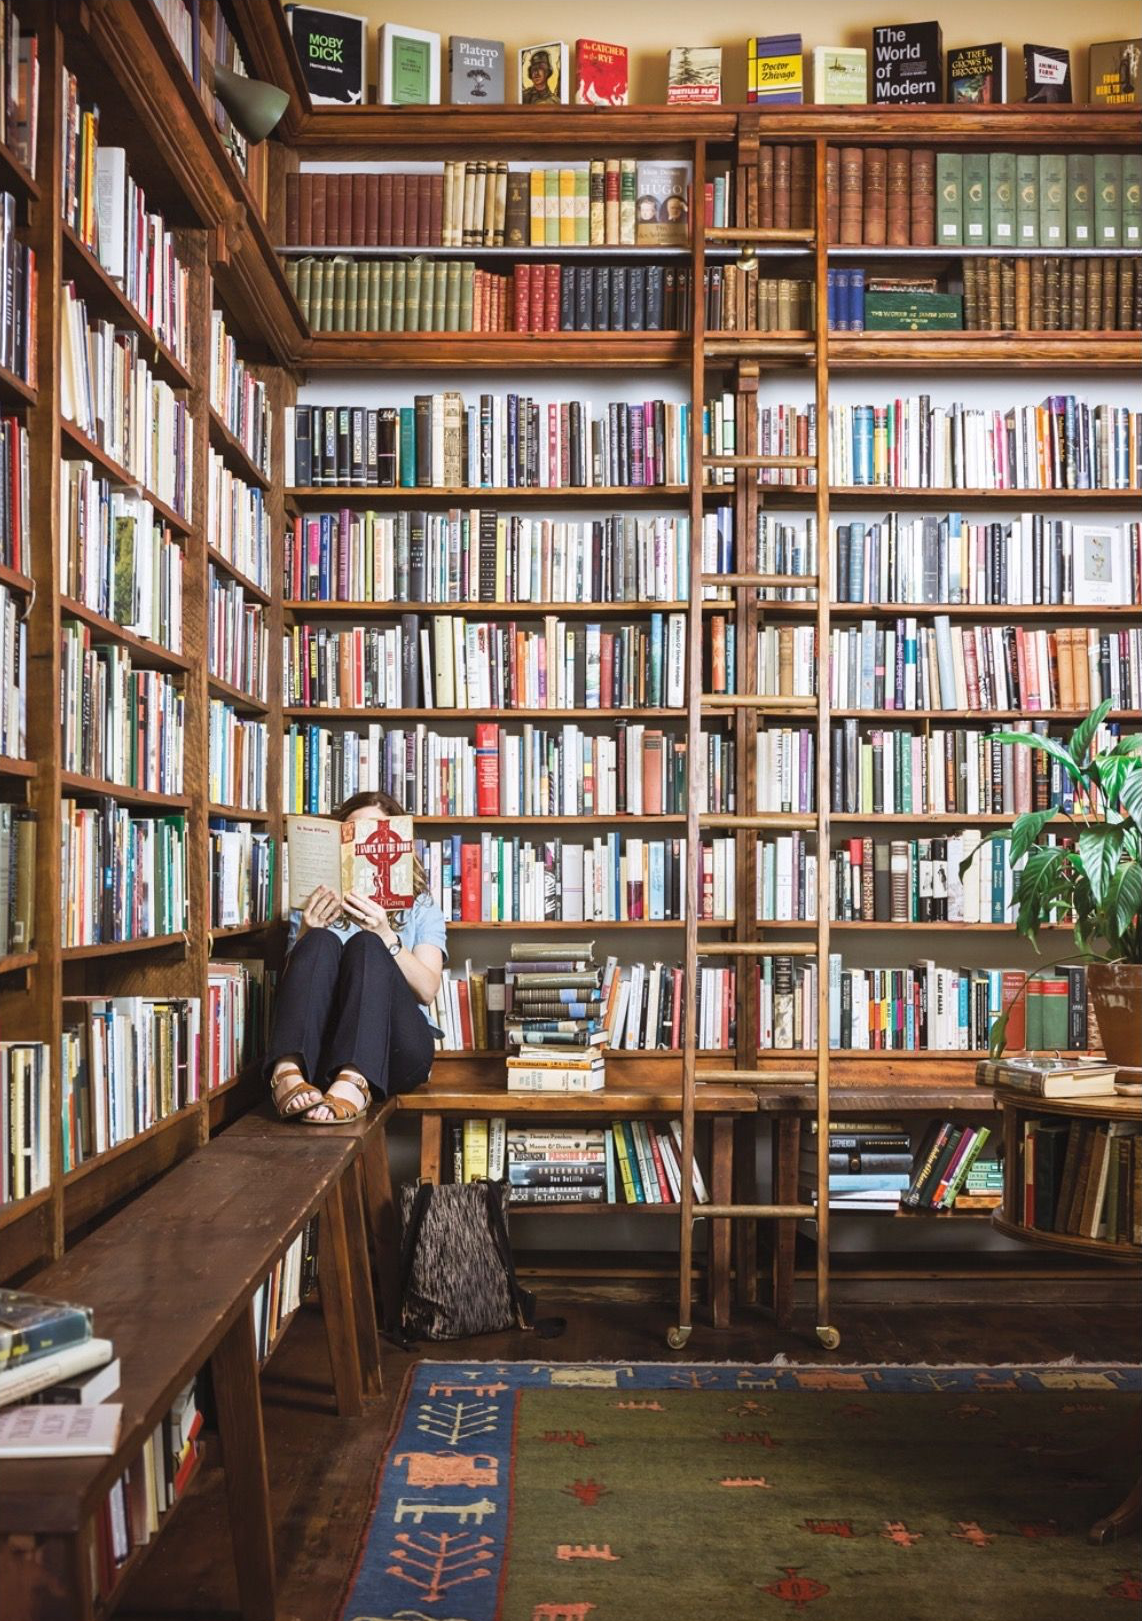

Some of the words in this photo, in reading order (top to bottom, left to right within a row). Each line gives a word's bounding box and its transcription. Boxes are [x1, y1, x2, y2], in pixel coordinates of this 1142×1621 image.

[309, 33, 343, 49] MOBY
[876, 28, 906, 44] The
[309, 45, 343, 63] DICK
[459, 43, 499, 58] Platero
[591, 43, 625, 57] CATCHER
[876, 43, 920, 61] World
[966, 49, 987, 59] TREE
[463, 56, 485, 67] and
[487, 58, 494, 69] I
[598, 54, 614, 64] RYE
[952, 60, 981, 69] GROWS
[984, 56, 993, 65] IN
[761, 63, 789, 72] Doctor
[876, 63, 893, 79] of
[951, 65, 993, 77] BROOKLYN
[761, 71, 796, 81] Zhivago
[876, 80, 936, 98] Modern
[640, 184, 682, 194] HUGO
[514, 1153, 546, 1161] KOSINSKI
[538, 1167, 595, 1175] UNDERWORLD
[550, 1175, 560, 1183] Don
